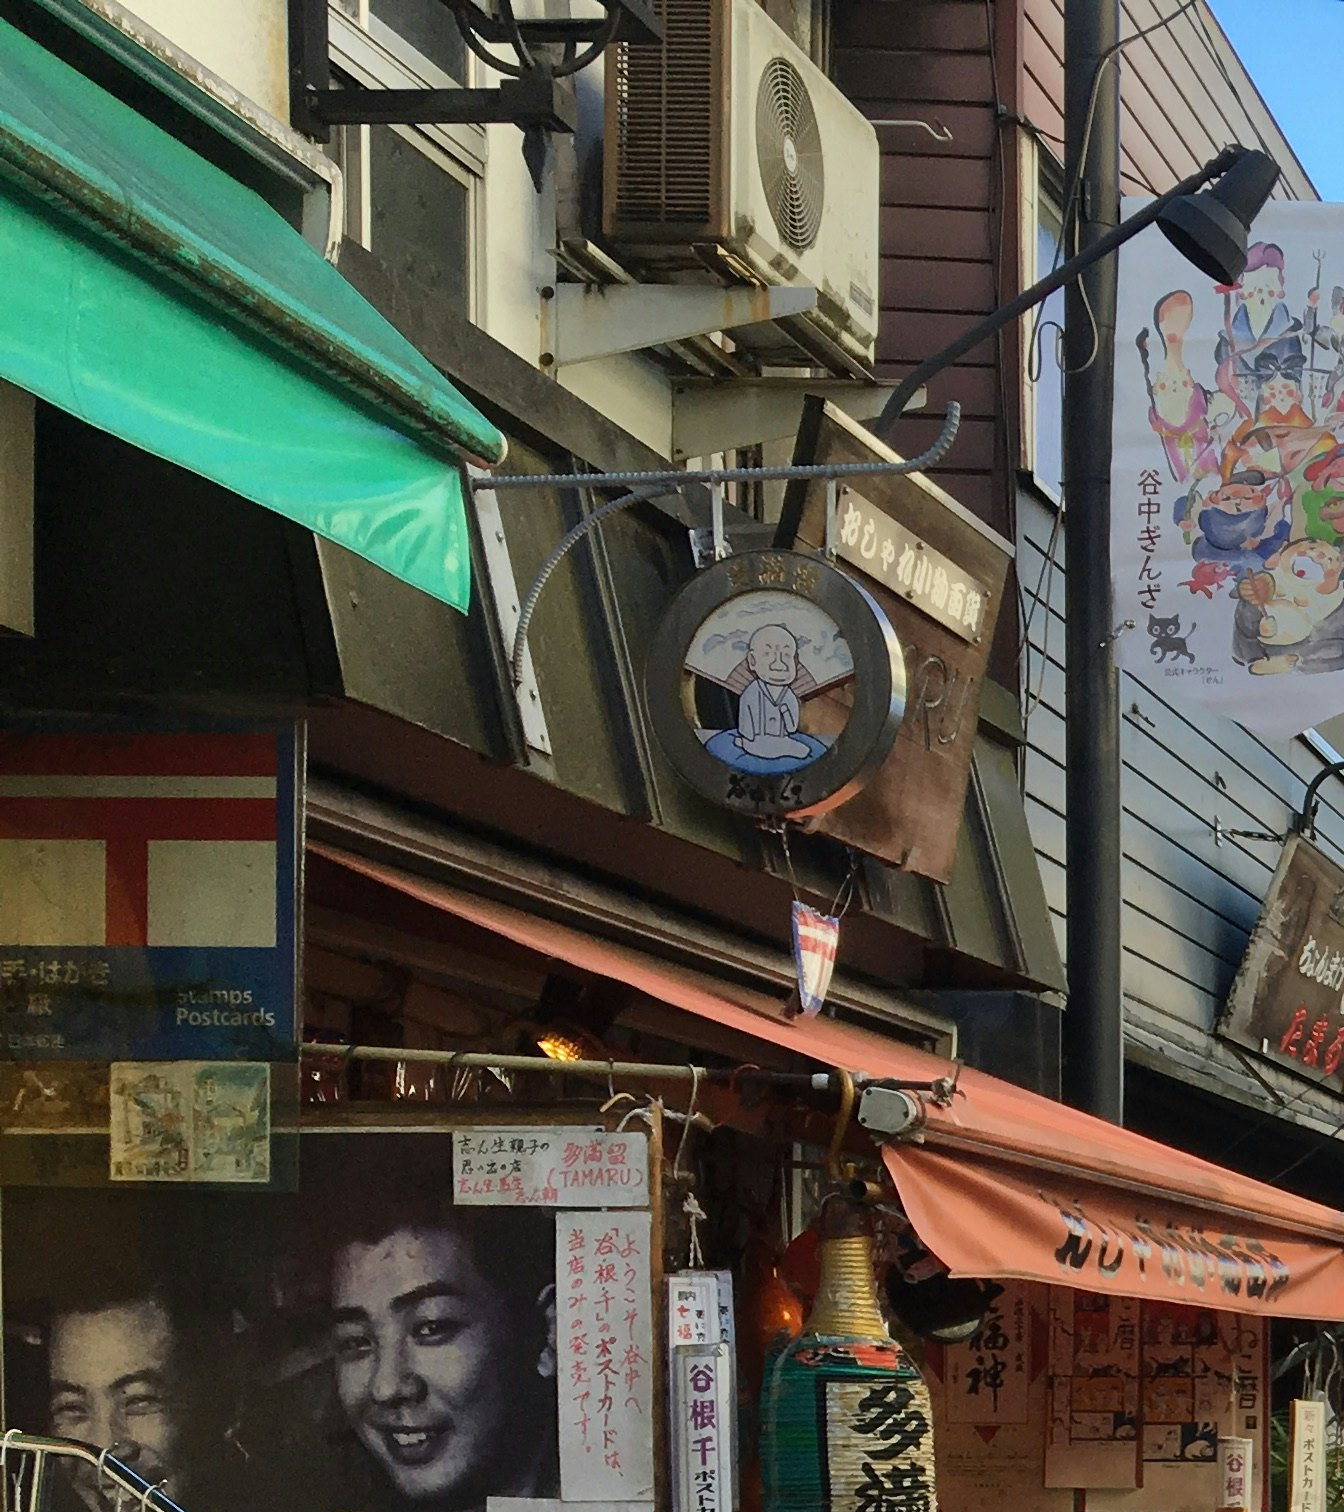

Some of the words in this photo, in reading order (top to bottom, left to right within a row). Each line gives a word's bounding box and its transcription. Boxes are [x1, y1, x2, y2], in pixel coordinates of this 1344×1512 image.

[1136, 469, 1163, 609] 谷中ぎんざ
[176, 1008, 275, 1026] Postcards
[561, 1140, 628, 1167] 多満留
[546, 1167, 644, 1188] (TAMARU)
[620, 1233, 649, 1415] ようこそ谷中へ
